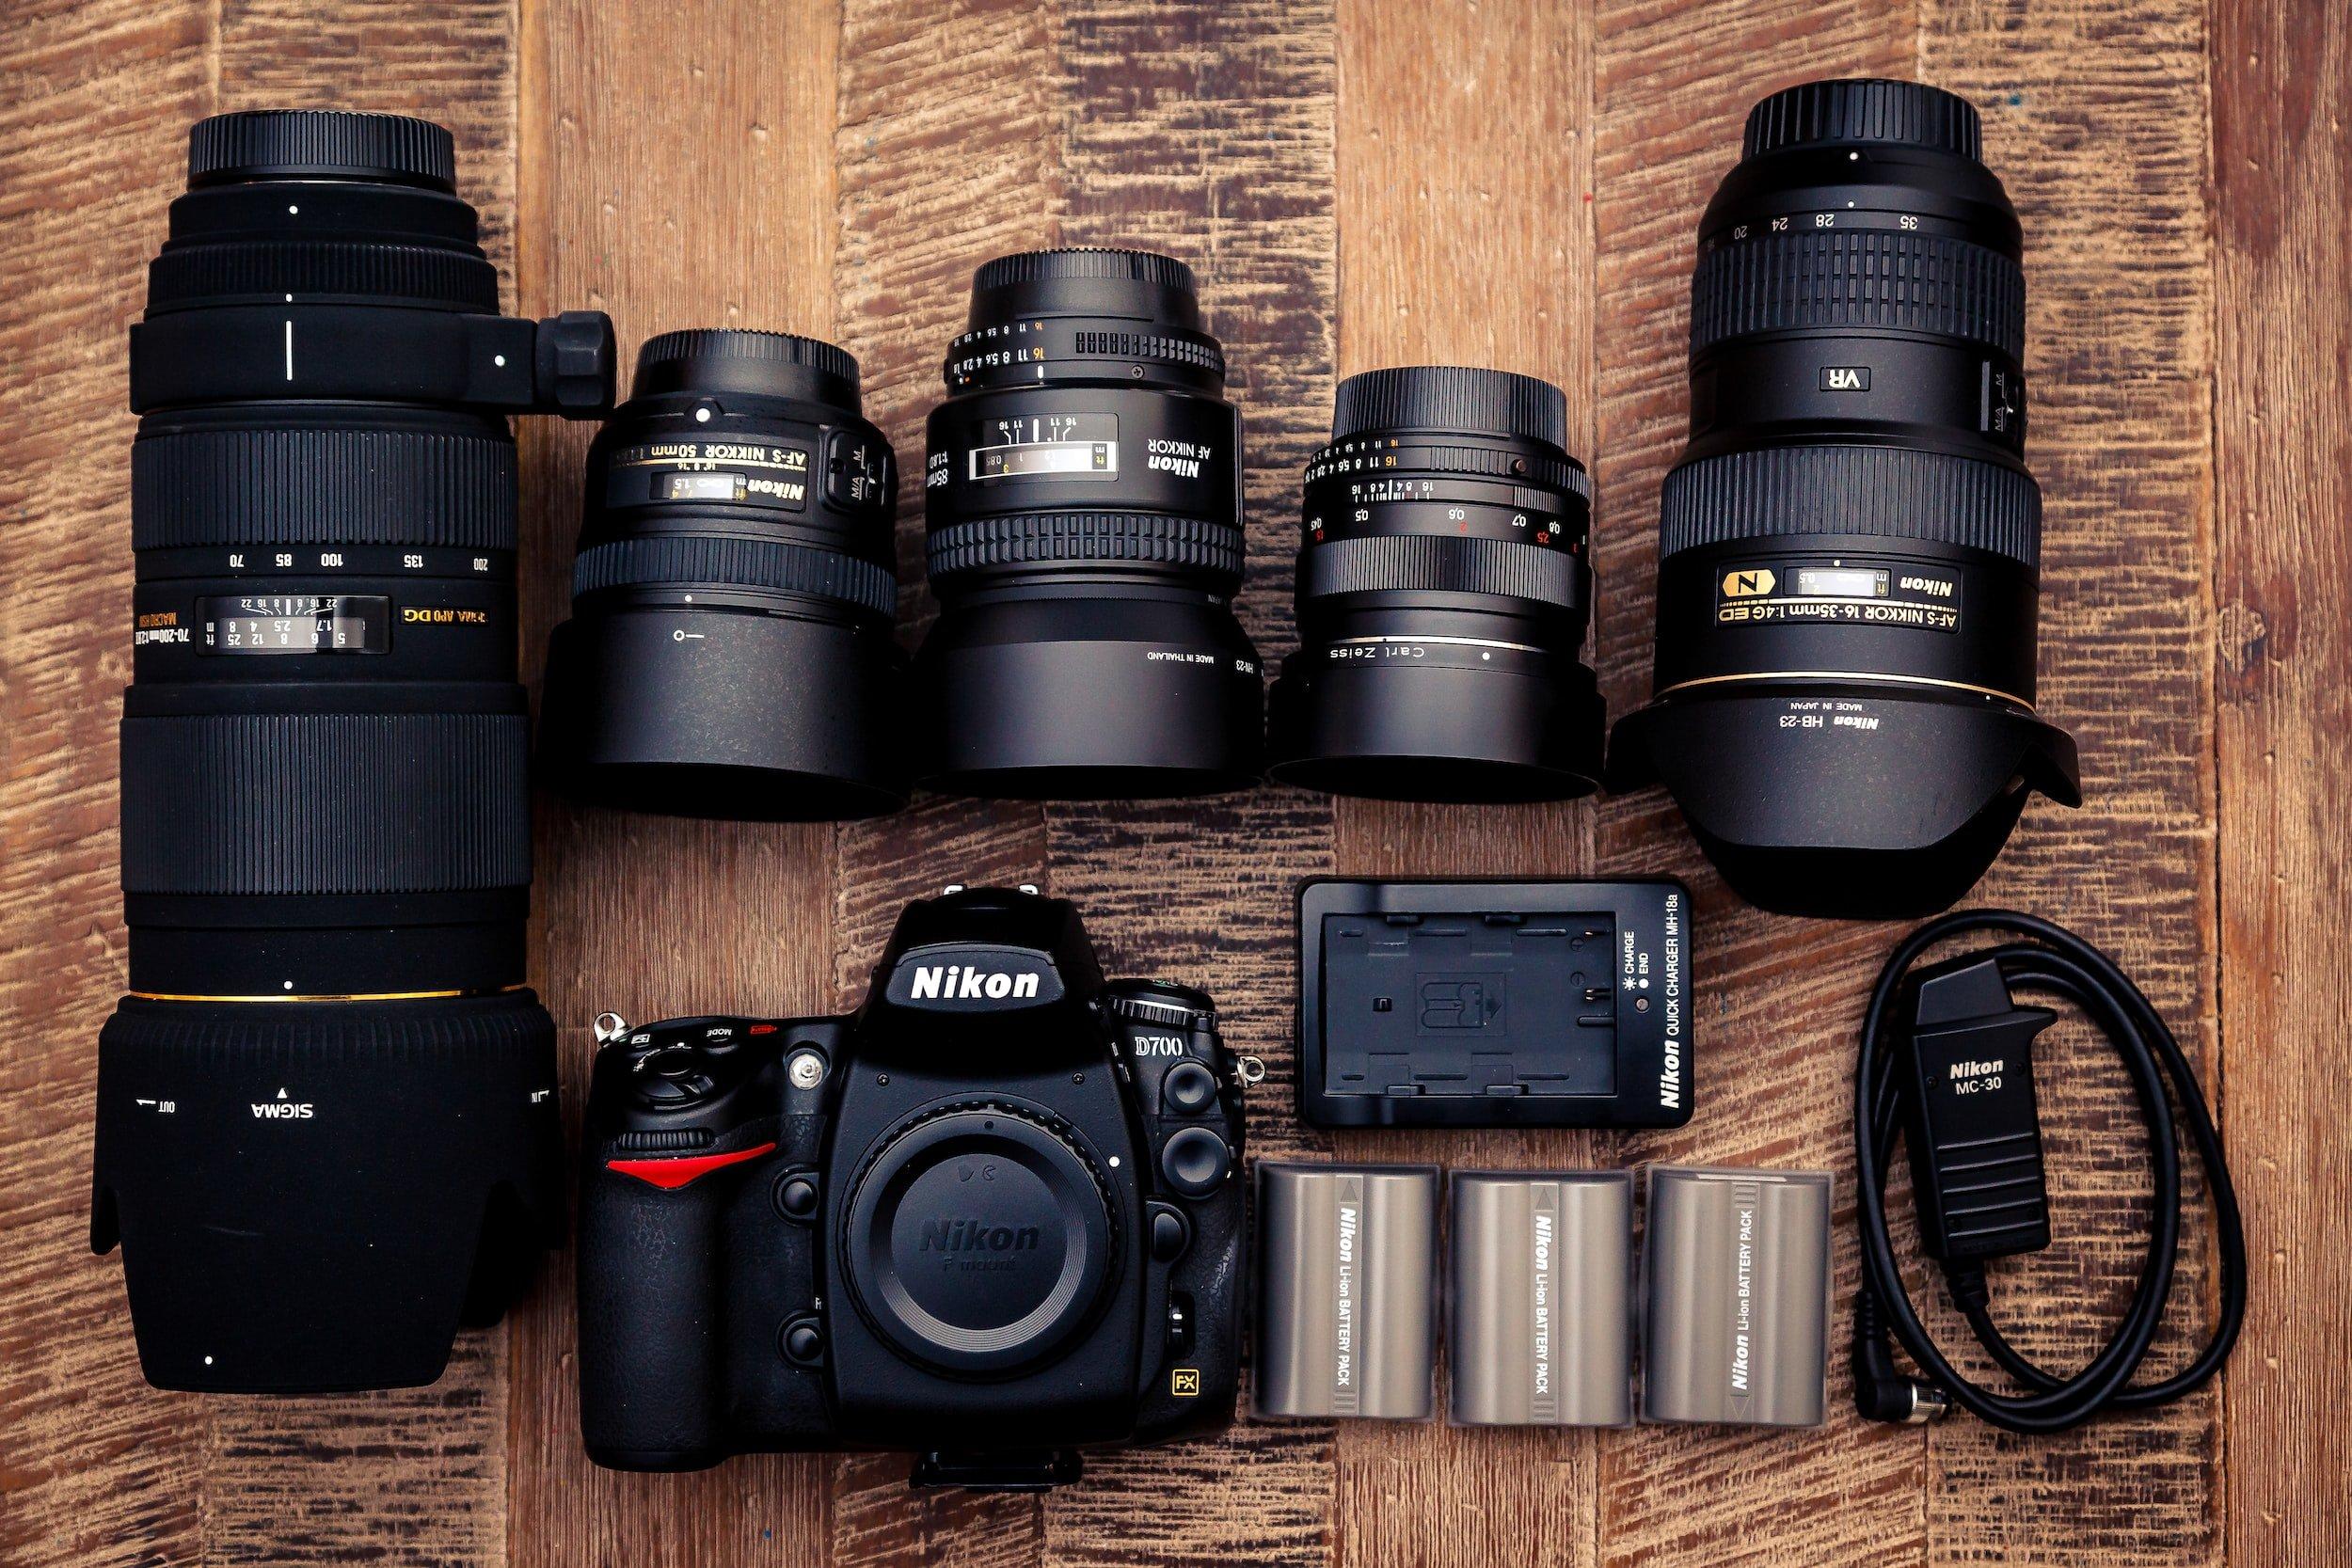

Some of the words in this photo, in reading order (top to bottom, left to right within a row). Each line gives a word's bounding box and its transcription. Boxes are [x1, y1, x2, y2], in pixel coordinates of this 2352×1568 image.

[1733, 225, 1747, 240] 20
[1772, 217, 1788, 230] 24
[1816, 214, 1835, 226] 28
[1899, 215, 1918, 230] 35
[1019, 323, 1025, 331] 11
[1035, 322, 1042, 330] 16
[986, 353, 998, 365] 5.6
[1003, 351, 1010, 363] 8
[1018, 349, 1027, 361] 11
[1033, 347, 1044, 359] 16
[976, 356, 982, 368] 4
[1828, 369, 1860, 388] VR
[998, 420, 1009, 430] 16
[1013, 420, 1023, 429] 11
[1050, 418, 1060, 427] 11
[1065, 417, 1077, 426] 16
[651, 444, 697, 457] 50mm
[705, 444, 765, 460] NIKKOR
[1148, 439, 1195, 455] NIKKOR
[1196, 446, 1211, 458] AF
[771, 449, 806, 463] AF-S
[853, 451, 861, 461] M
[1095, 455, 1104, 464] ft
[1369, 456, 1379, 468] 11
[1385, 455, 1397, 467] 16
[1148, 455, 1200, 478] Nikon
[1355, 458, 1361, 469] 8
[675, 478, 690, 488] 1.5
[736, 478, 746, 486] m
[851, 476, 860, 499] M/A
[1370, 483, 1375, 493] 8
[1378, 483, 1385, 491] 4
[1396, 482, 1403, 491] 4
[1406, 482, 1412, 491] 8
[1422, 482, 1434, 491] 16
[748, 478, 804, 501] Nikon
[1352, 484, 1361, 495] 16
[1356, 509, 1368, 521] 0,5
[1449, 508, 1464, 521] 0,6
[1512, 514, 1526, 527] 0,7
[230, 554, 245, 568] 70
[276, 553, 293, 567] 85
[321, 552, 344, 567] 100
[404, 554, 423, 569] 135
[1738, 573, 1757, 594] N
[1899, 575, 1952, 597] Nikon
[241, 598, 252, 608] 22
[258, 598, 266, 608] 16
[274, 598, 279, 608] 8
[297, 598, 303, 608] 8
[326, 598, 338, 608] 22
[404, 610, 431, 622] DG
[1719, 608, 1749, 621] ED
[1753, 606, 1786, 619] 1:4G
[1789, 604, 1860, 620] 16-35mm
[1865, 606, 1923, 624] NIKKOR
[274, 620, 291, 631] 2.5
[315, 620, 332, 631] 1.7
[1927, 612, 1956, 627] AF-S
[229, 622, 235, 632] 8
[250, 621, 258, 632] 4
[228, 634, 241, 645] 25
[252, 633, 263, 645] 12
[280, 633, 288, 644] 8
[310, 633, 319, 644] 6
[338, 632, 346, 643] 5
[1147, 652, 1185, 661] THAILAND
[1330, 647, 1375, 659] Zeiss
[1386, 647, 1424, 658] Carl
[1195, 655, 1214, 664] MADE
[1790, 702, 1819, 711] JAPAN
[1836, 703, 1863, 711] MADE
[1779, 715, 1823, 728] HB-23
[1833, 716, 1879, 730] Nikon
[1666, 895, 1678, 935] MH-18a
[1625, 931, 1634, 974] CHARGE
[1639, 953, 1648, 974] END
[1666, 939, 1678, 996] CHARGER
[910, 965, 1040, 999] Nikon
[1667, 999, 1679, 1036] QUICK
[707, 1029, 732, 1037] MODE
[1135, 1036, 1184, 1056] D700
[1661, 1039, 1679, 1108] Nikon
[1950, 1060, 2004, 1079] Nikon
[1956, 1077, 2002, 1095] MC-30
[159, 1101, 176, 1113] OUT
[251, 1103, 313, 1118] SIGMA
[1739, 1210, 1753, 1241] PACK
[919, 1219, 1041, 1252] Nikon
[1338, 1208, 1356, 1263] Nikon
[1534, 1215, 1552, 1271] Nikon
[1737, 1243, 1751, 1298] BATTERY
[1337, 1266, 1351, 1298] Li-ion
[1534, 1274, 1549, 1306] Li-ion
[1737, 1299, 1749, 1331] Li-ion
[1337, 1299, 1351, 1353] BATTERY
[1534, 1307, 1549, 1360] BATTERY
[1731, 1335, 1749, 1390] Nikon
[1337, 1354, 1351, 1386] PACK
[1176, 1375, 1196, 1389] FX
[1534, 1363, 1549, 1394] PACK
